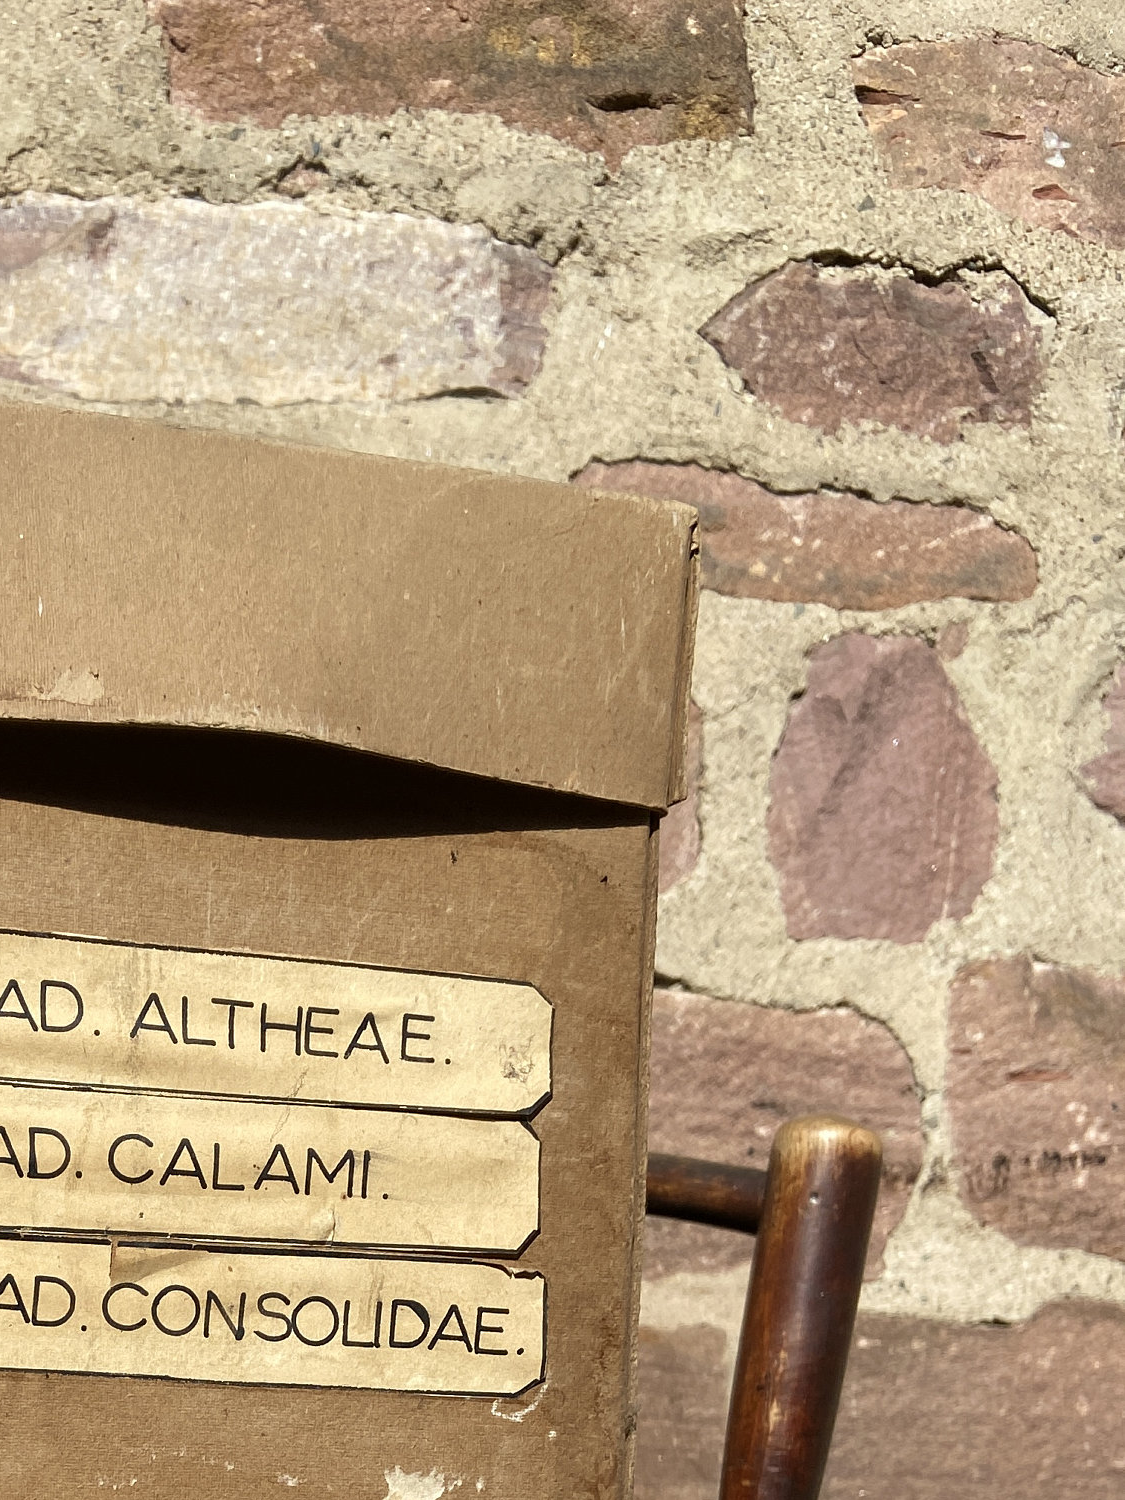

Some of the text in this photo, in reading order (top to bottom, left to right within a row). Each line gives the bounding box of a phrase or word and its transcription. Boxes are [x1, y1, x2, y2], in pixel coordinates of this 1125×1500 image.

[130, 993, 452, 1066] ALTHEAE.
[107, 1133, 390, 1200] CALAMI.
[101, 1282, 526, 1356] CONSOLIDAE.
